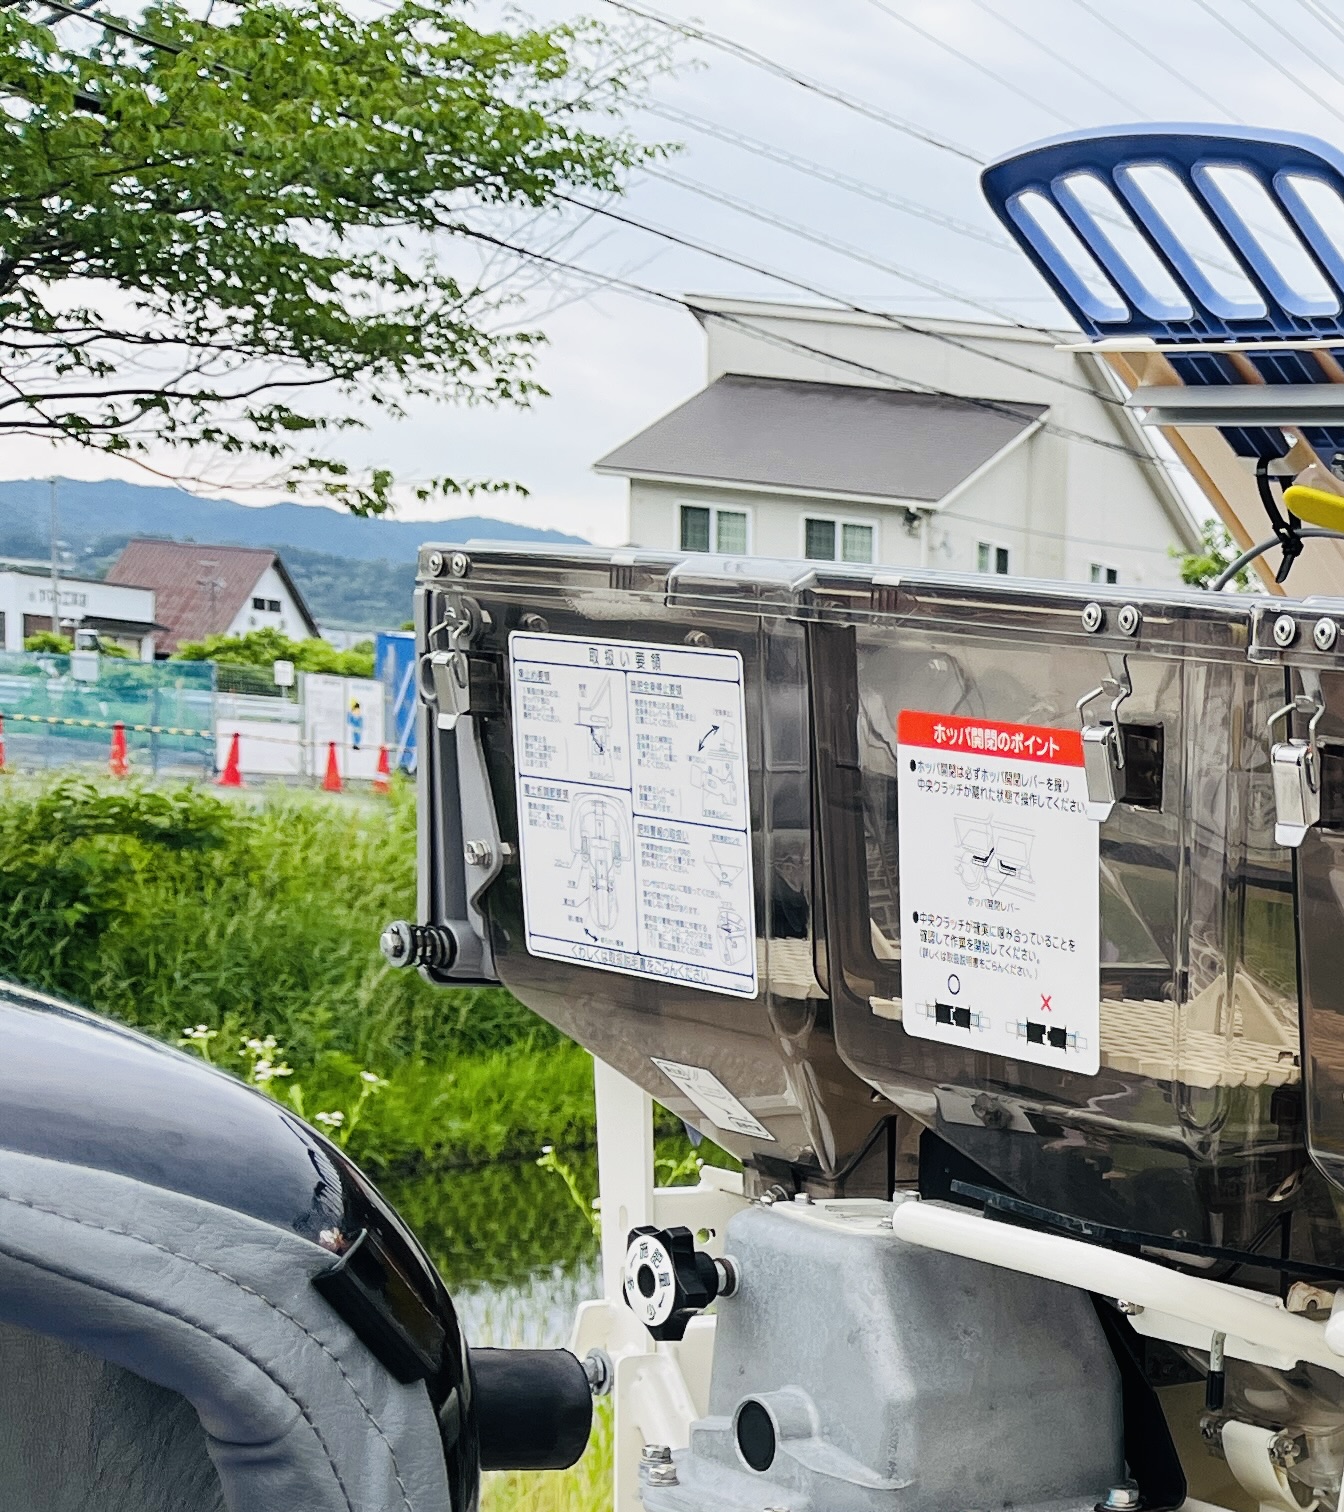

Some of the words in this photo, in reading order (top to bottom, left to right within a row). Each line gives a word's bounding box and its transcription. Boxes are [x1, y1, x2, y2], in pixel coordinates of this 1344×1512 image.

[588, 647, 661, 671] 取扱い要領
[933, 722, 1059, 759] ホッパ開閉のポイント
